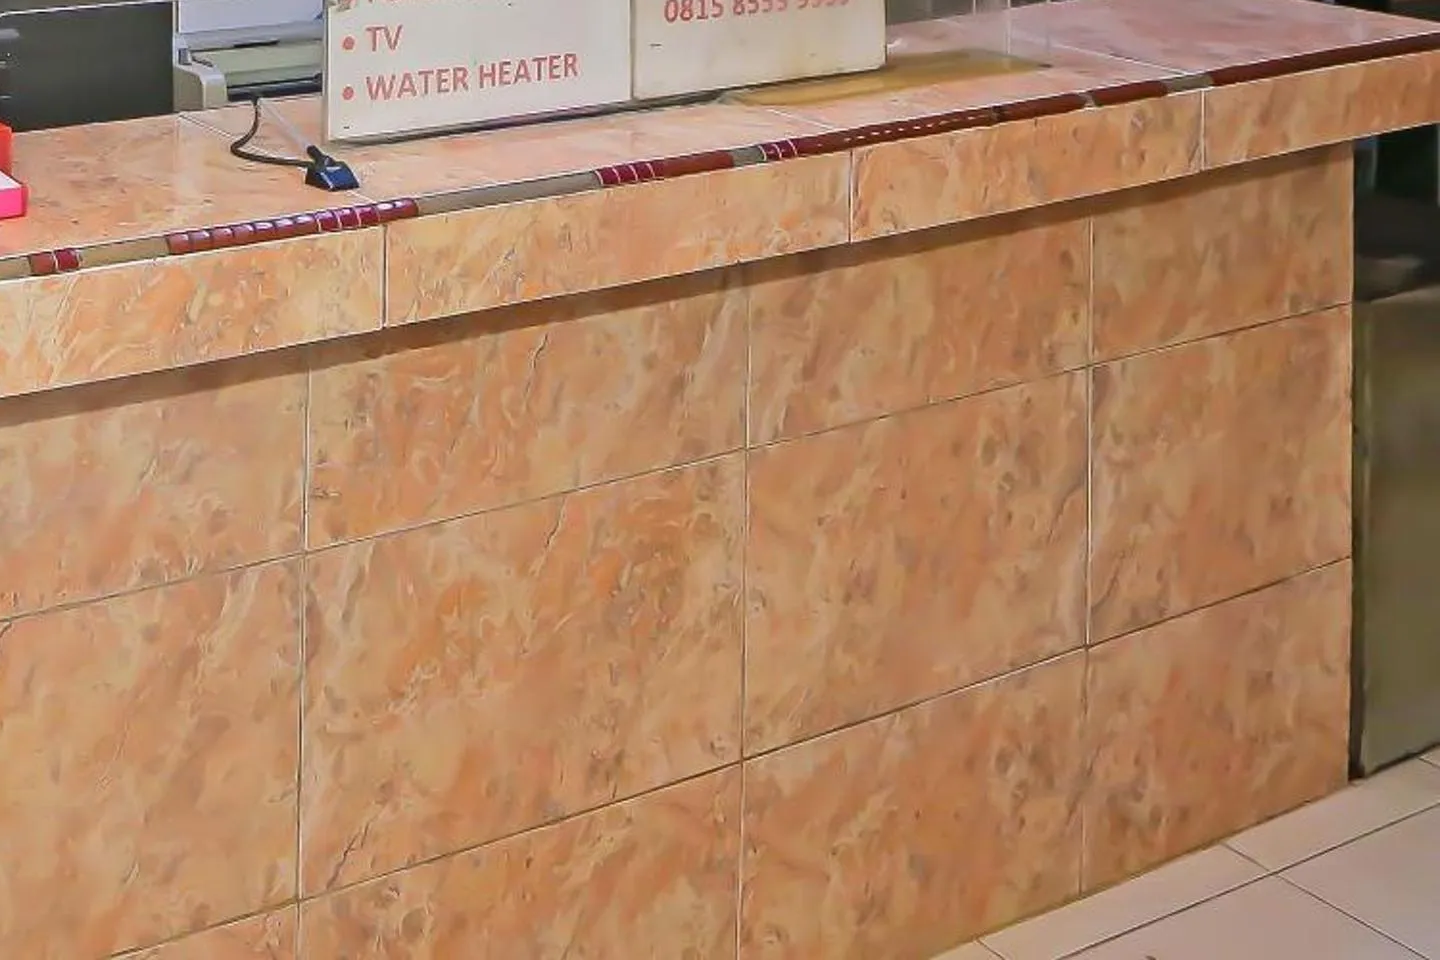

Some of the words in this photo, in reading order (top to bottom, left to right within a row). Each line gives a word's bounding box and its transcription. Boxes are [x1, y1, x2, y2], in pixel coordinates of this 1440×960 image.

[366, 24, 404, 52] TV
[366, 66, 469, 101] WATER
[478, 52, 579, 89] HEATER
